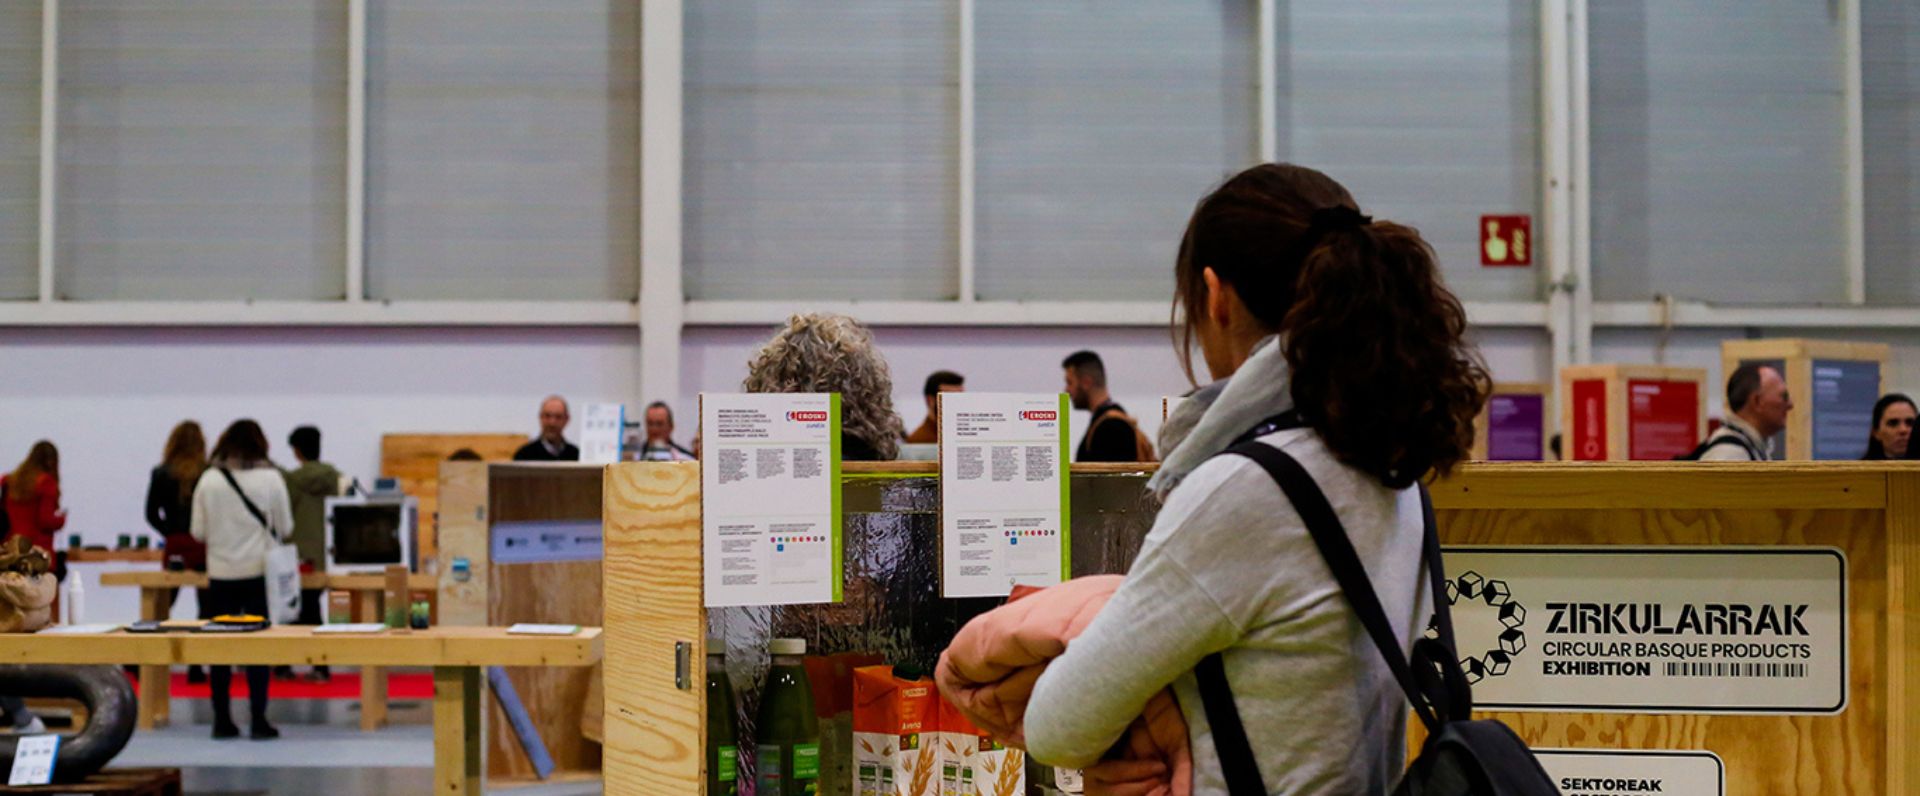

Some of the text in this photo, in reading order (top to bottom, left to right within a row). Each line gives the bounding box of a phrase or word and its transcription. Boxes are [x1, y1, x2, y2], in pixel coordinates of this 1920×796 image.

[1545, 602, 1810, 636] ZIRKULARRAK
[1543, 641, 1811, 659] CIRCULAR BASQUE PRODUCTS
[1543, 660, 1651, 676] EXHIBITION
[1561, 777, 1662, 792] SEKTOREAK
